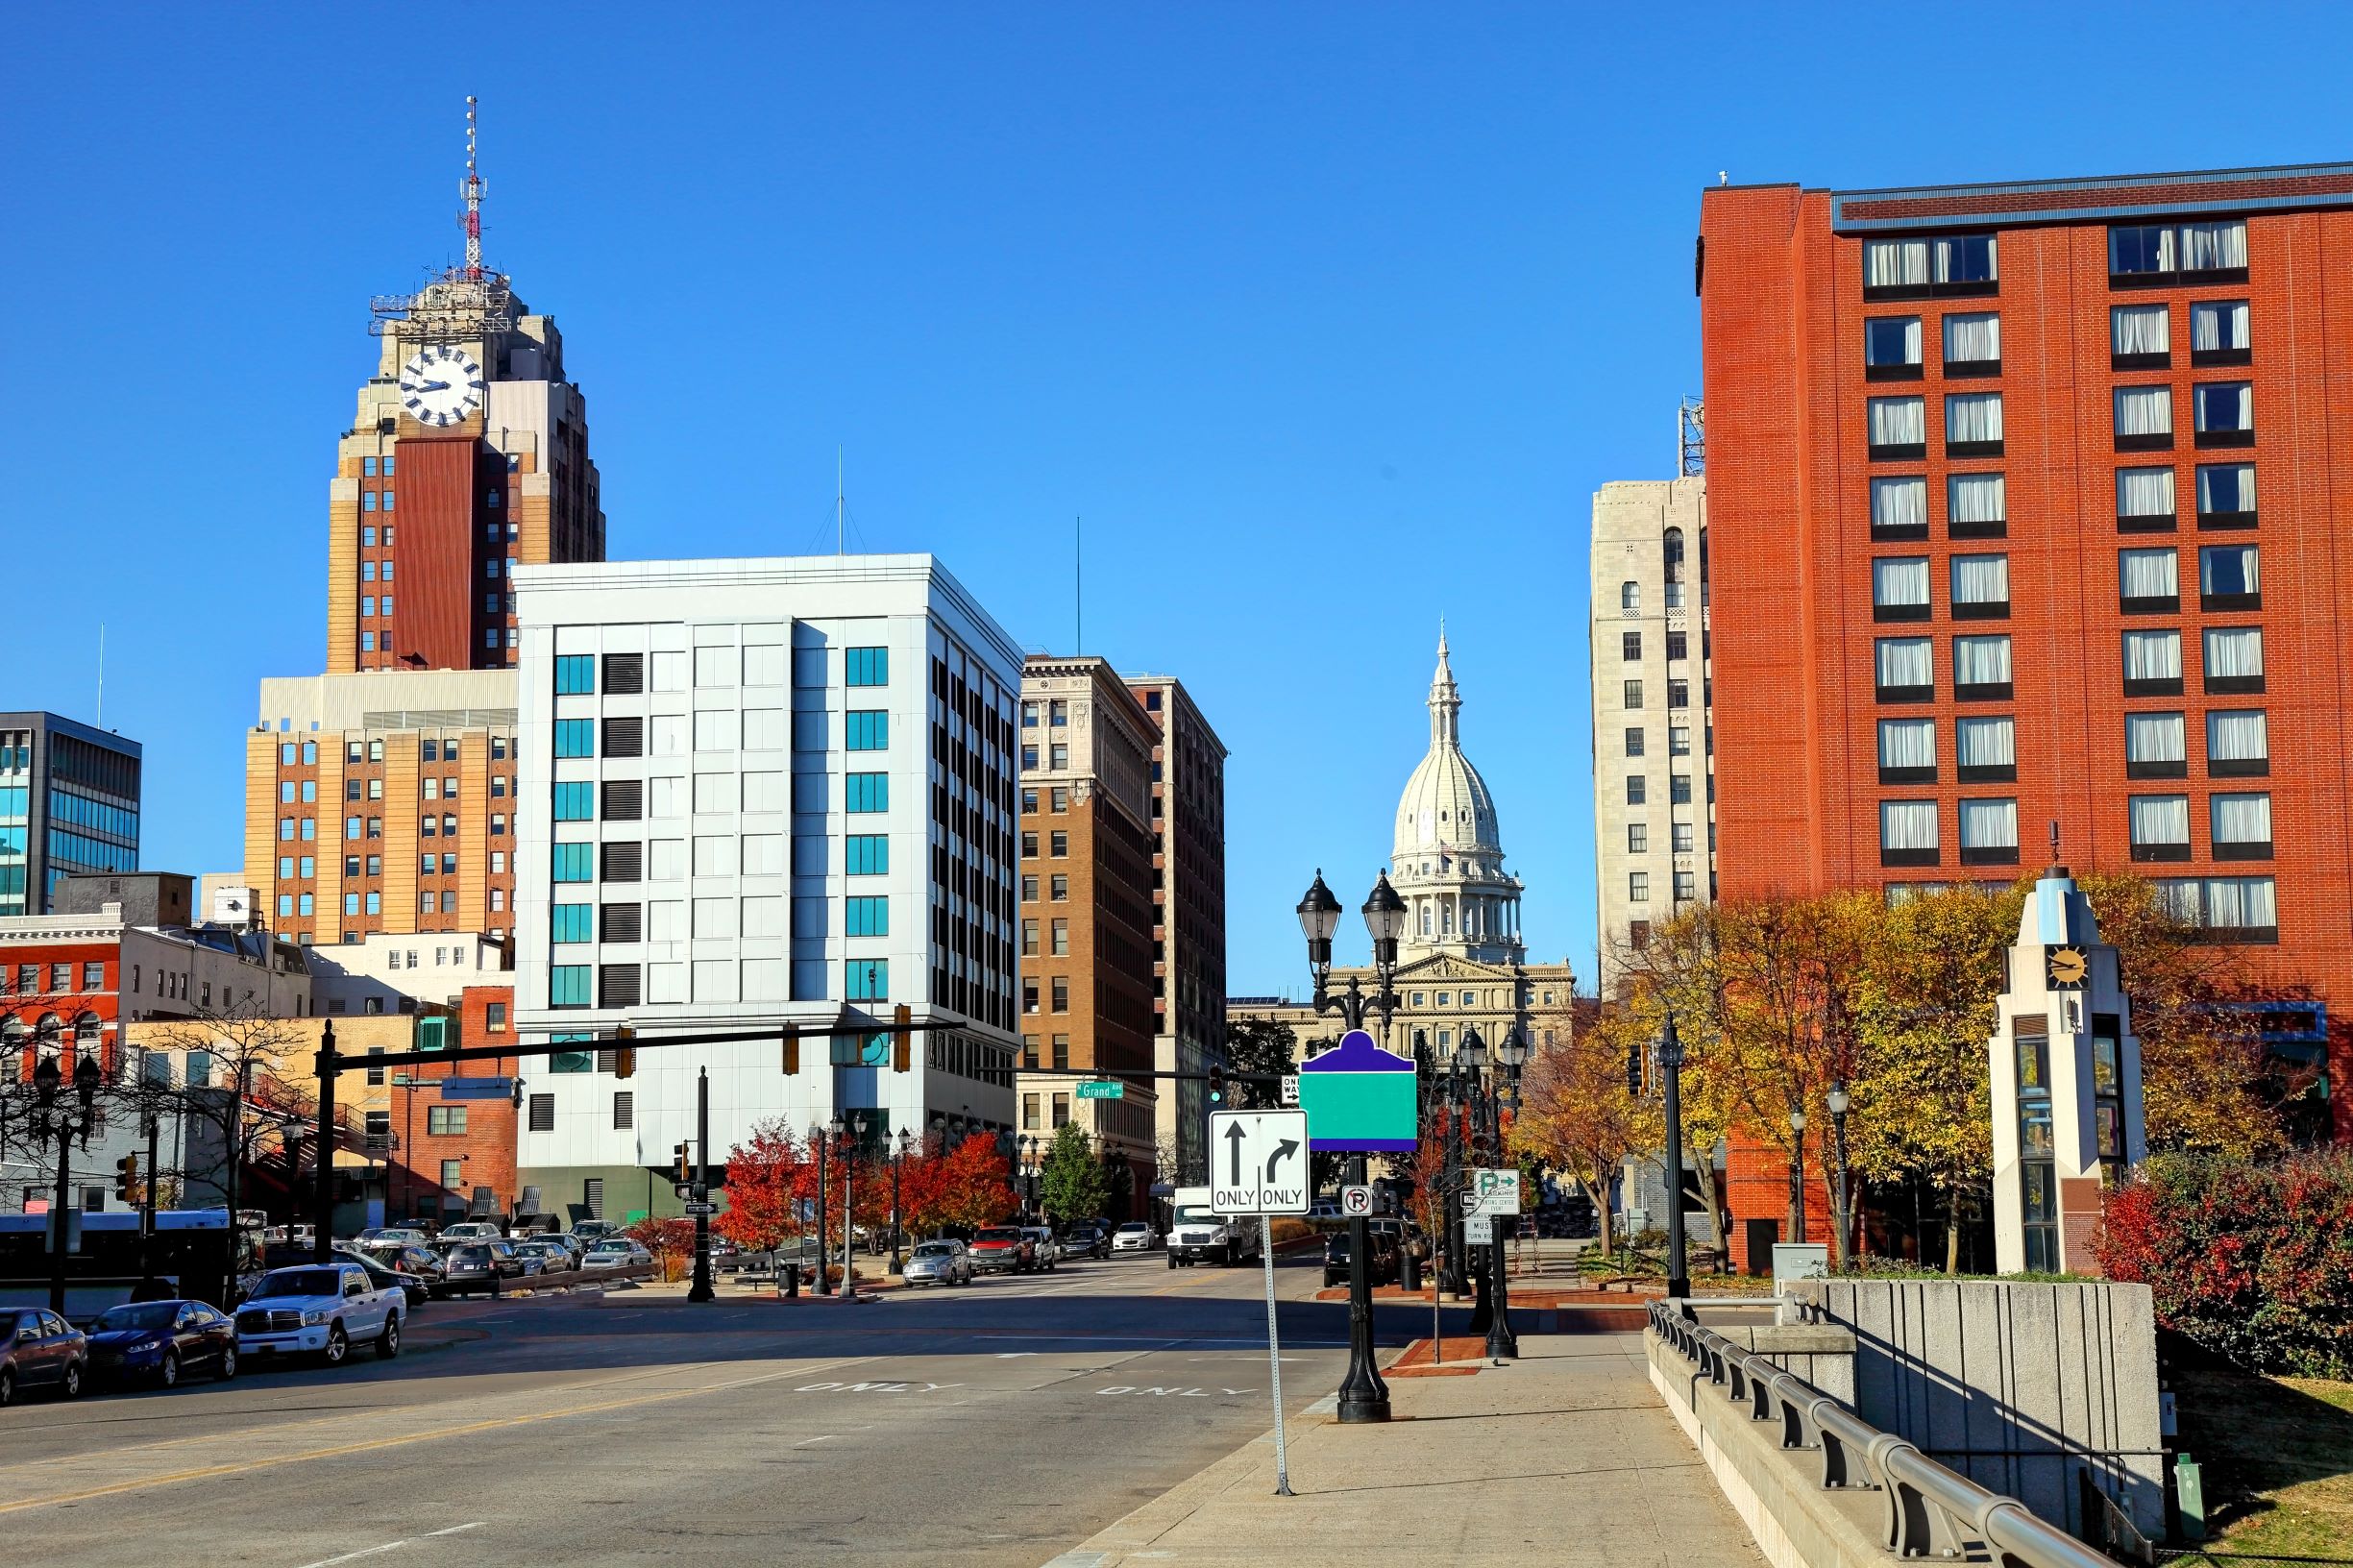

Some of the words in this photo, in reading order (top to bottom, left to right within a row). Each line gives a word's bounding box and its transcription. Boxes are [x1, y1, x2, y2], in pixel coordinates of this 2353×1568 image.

[1083, 1085, 1109, 1096] Grand
[1216, 1190, 1255, 1205] ONLY
[1263, 1189, 1302, 1204] ONLY
[793, 1383, 965, 1392] ONLY
[1095, 1387, 1259, 1396] ONLY
